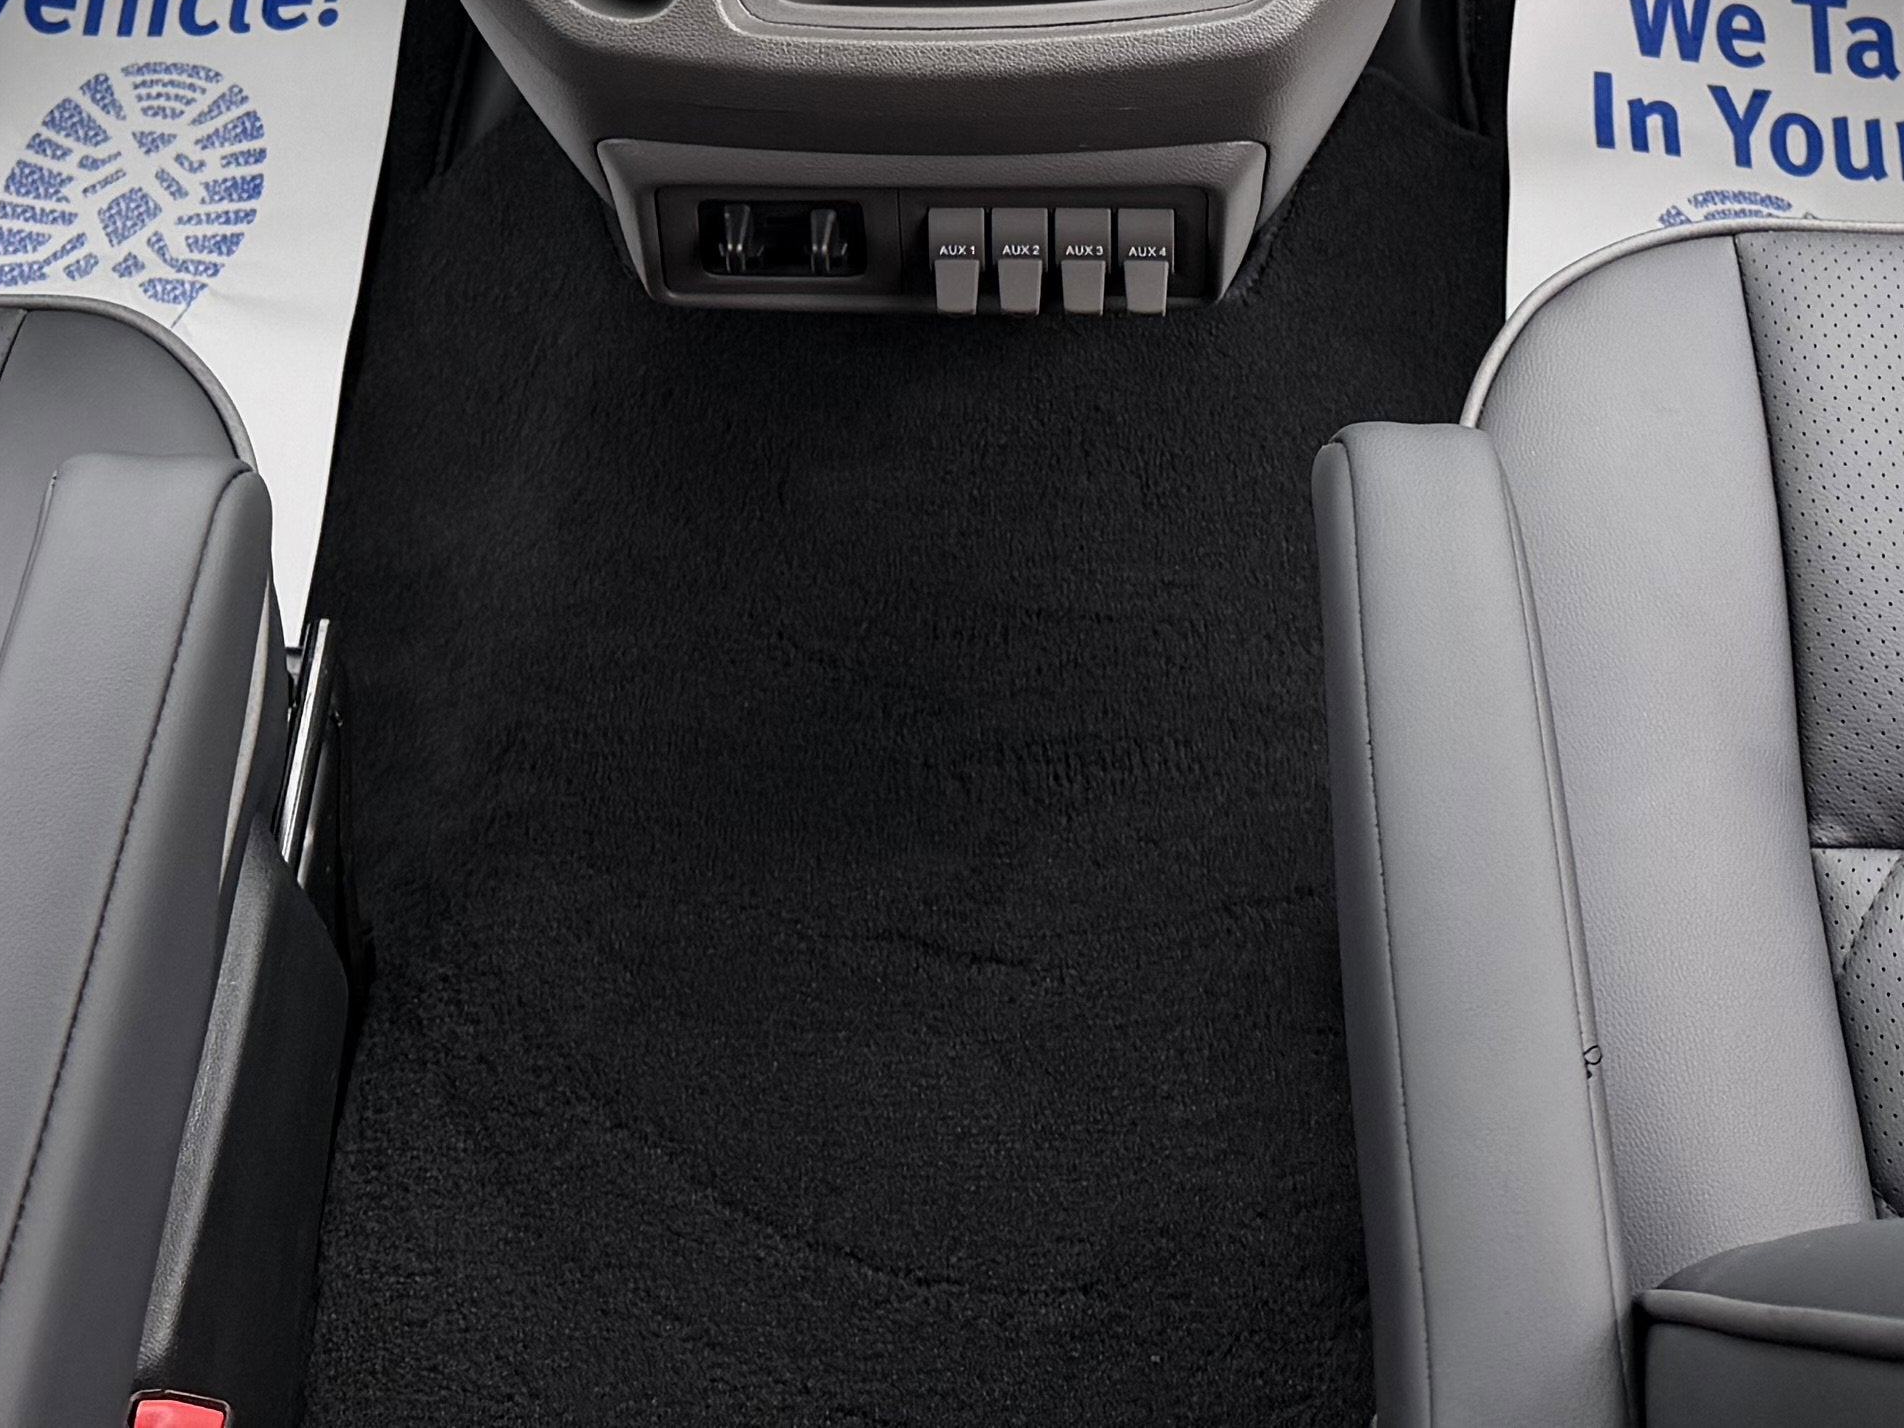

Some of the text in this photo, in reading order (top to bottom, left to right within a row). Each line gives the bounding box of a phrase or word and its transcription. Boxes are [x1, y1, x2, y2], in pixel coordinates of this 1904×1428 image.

[1591, 70, 1683, 158] In
[939, 245, 976, 256] AUX 1
[1002, 245, 1041, 256] AUX 2
[1065, 245, 1104, 256] AUX 3
[1128, 246, 1168, 257] AUX 4
